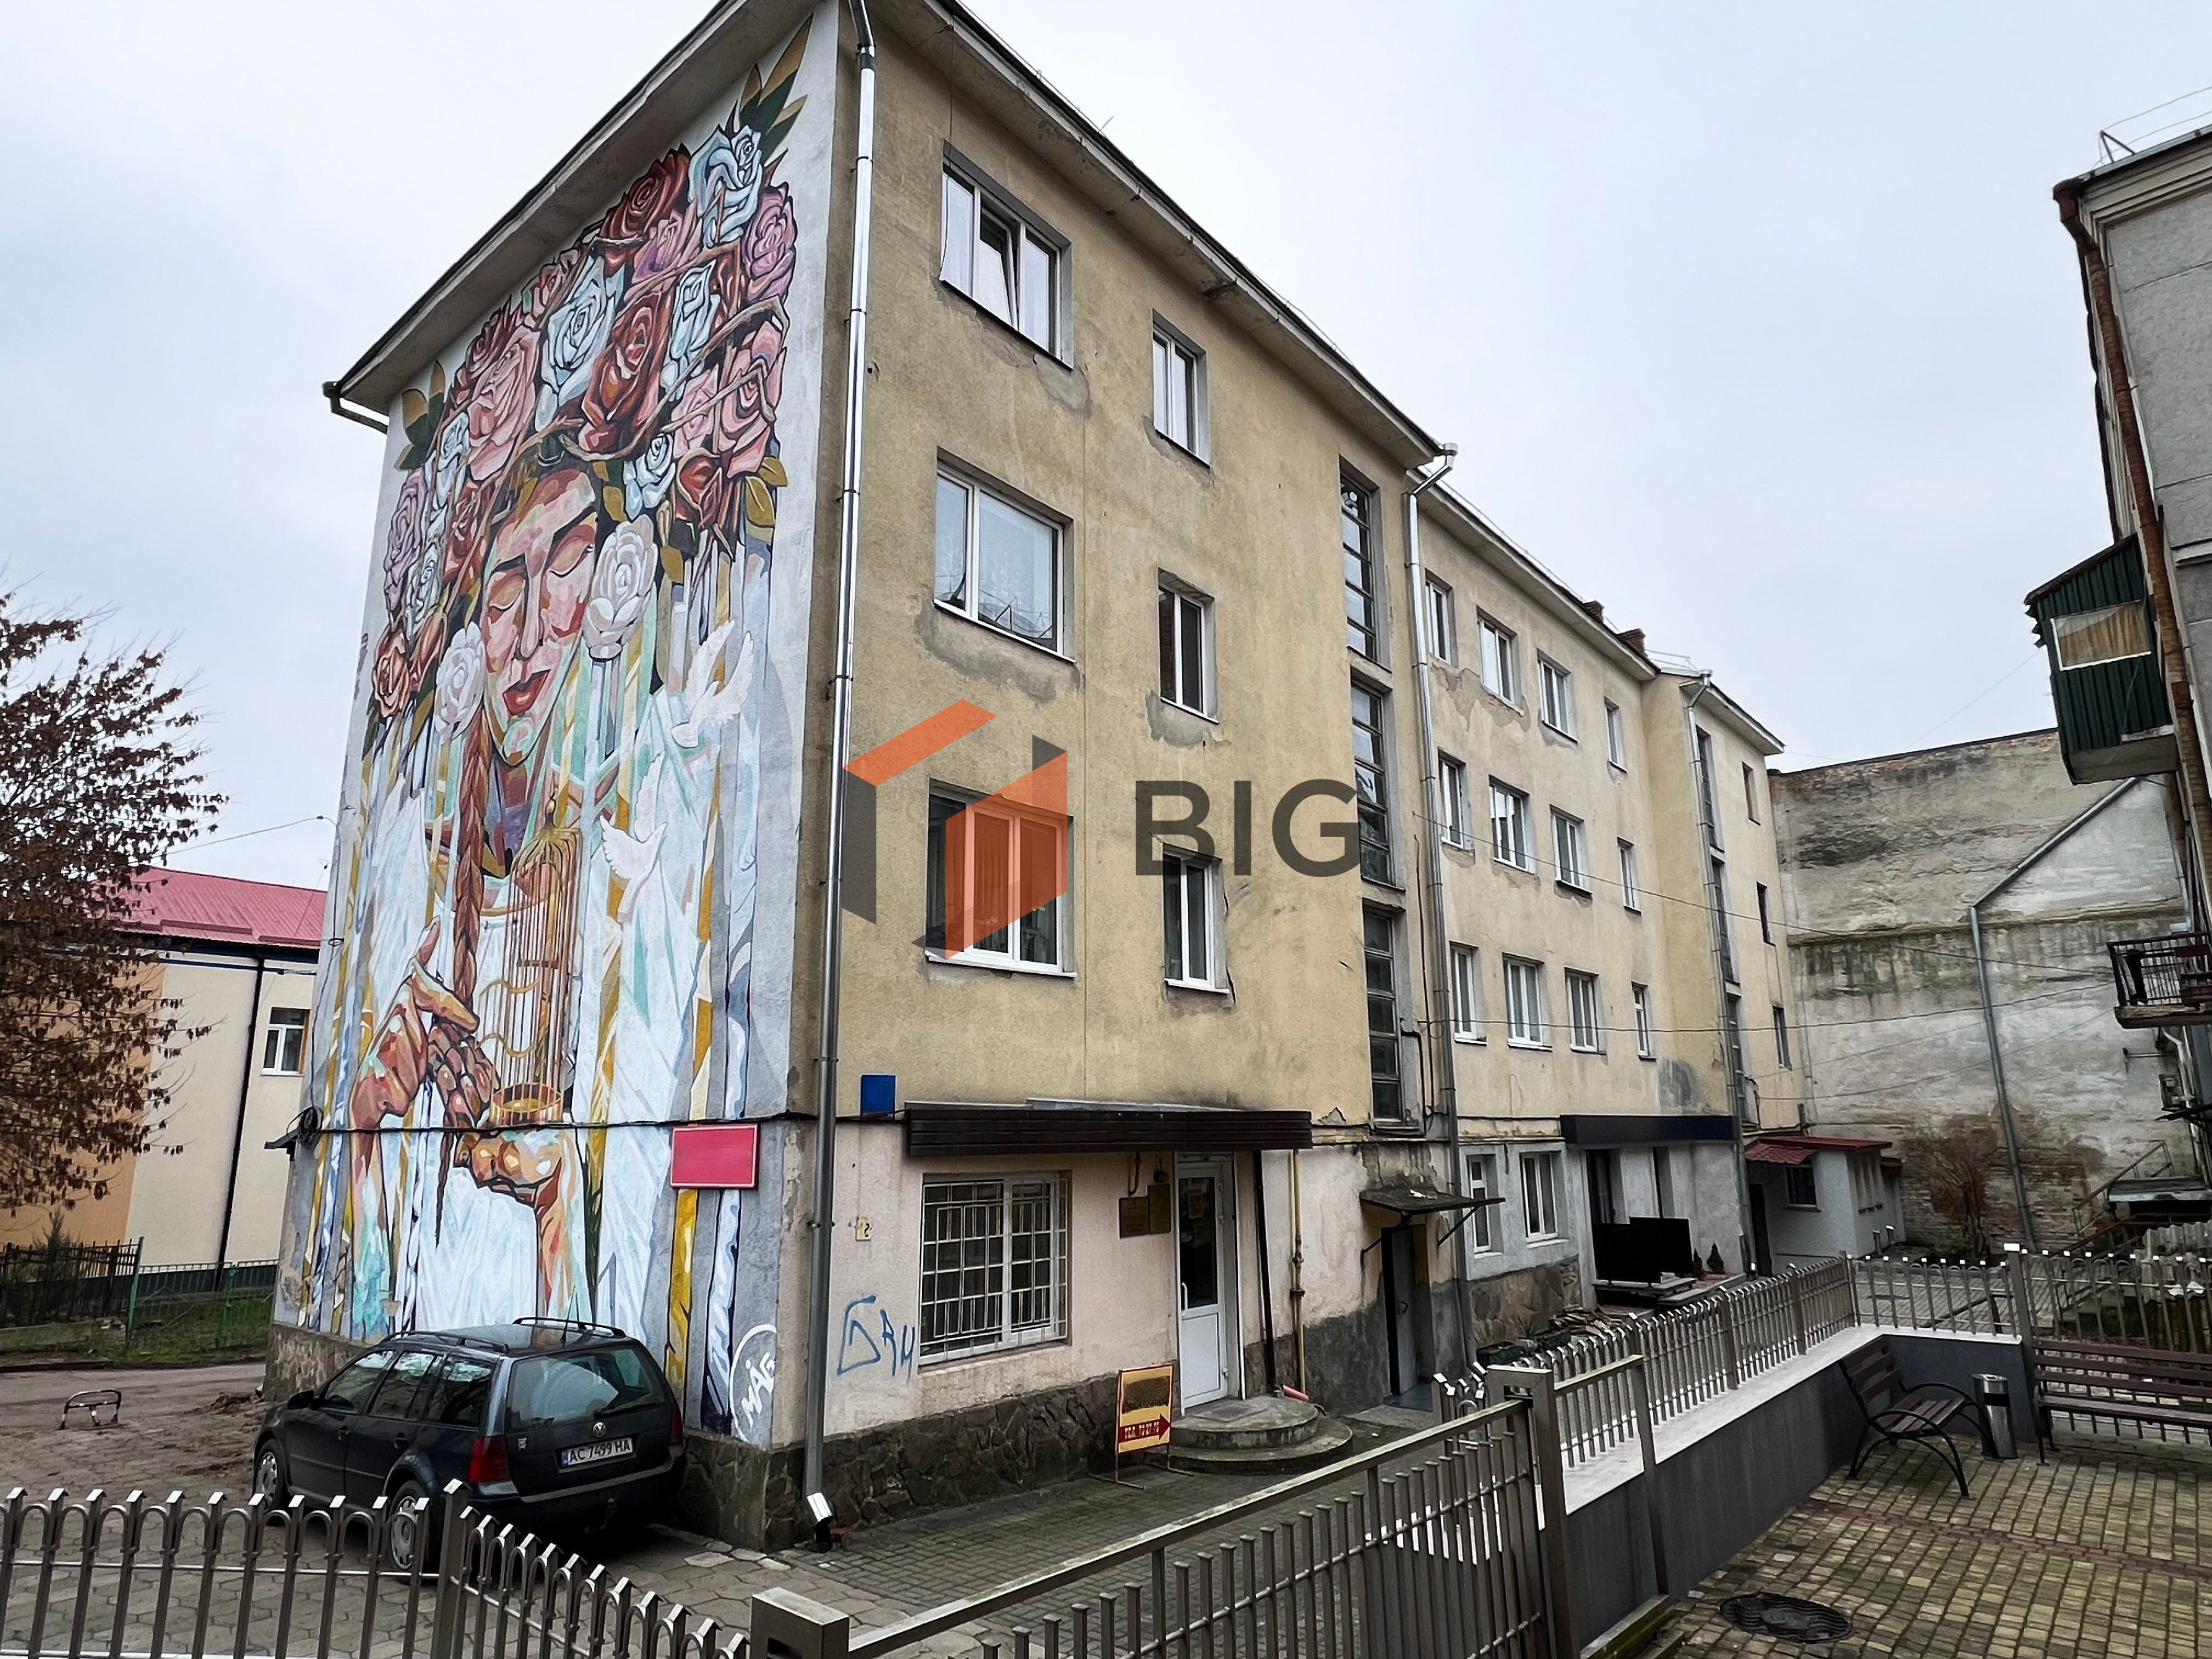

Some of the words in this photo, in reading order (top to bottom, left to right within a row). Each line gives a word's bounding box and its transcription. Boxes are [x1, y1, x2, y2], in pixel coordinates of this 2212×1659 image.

[569, 1448, 586, 1463] AC
[588, 1443, 612, 1458] 7499
[614, 1439, 630, 1453] HA
